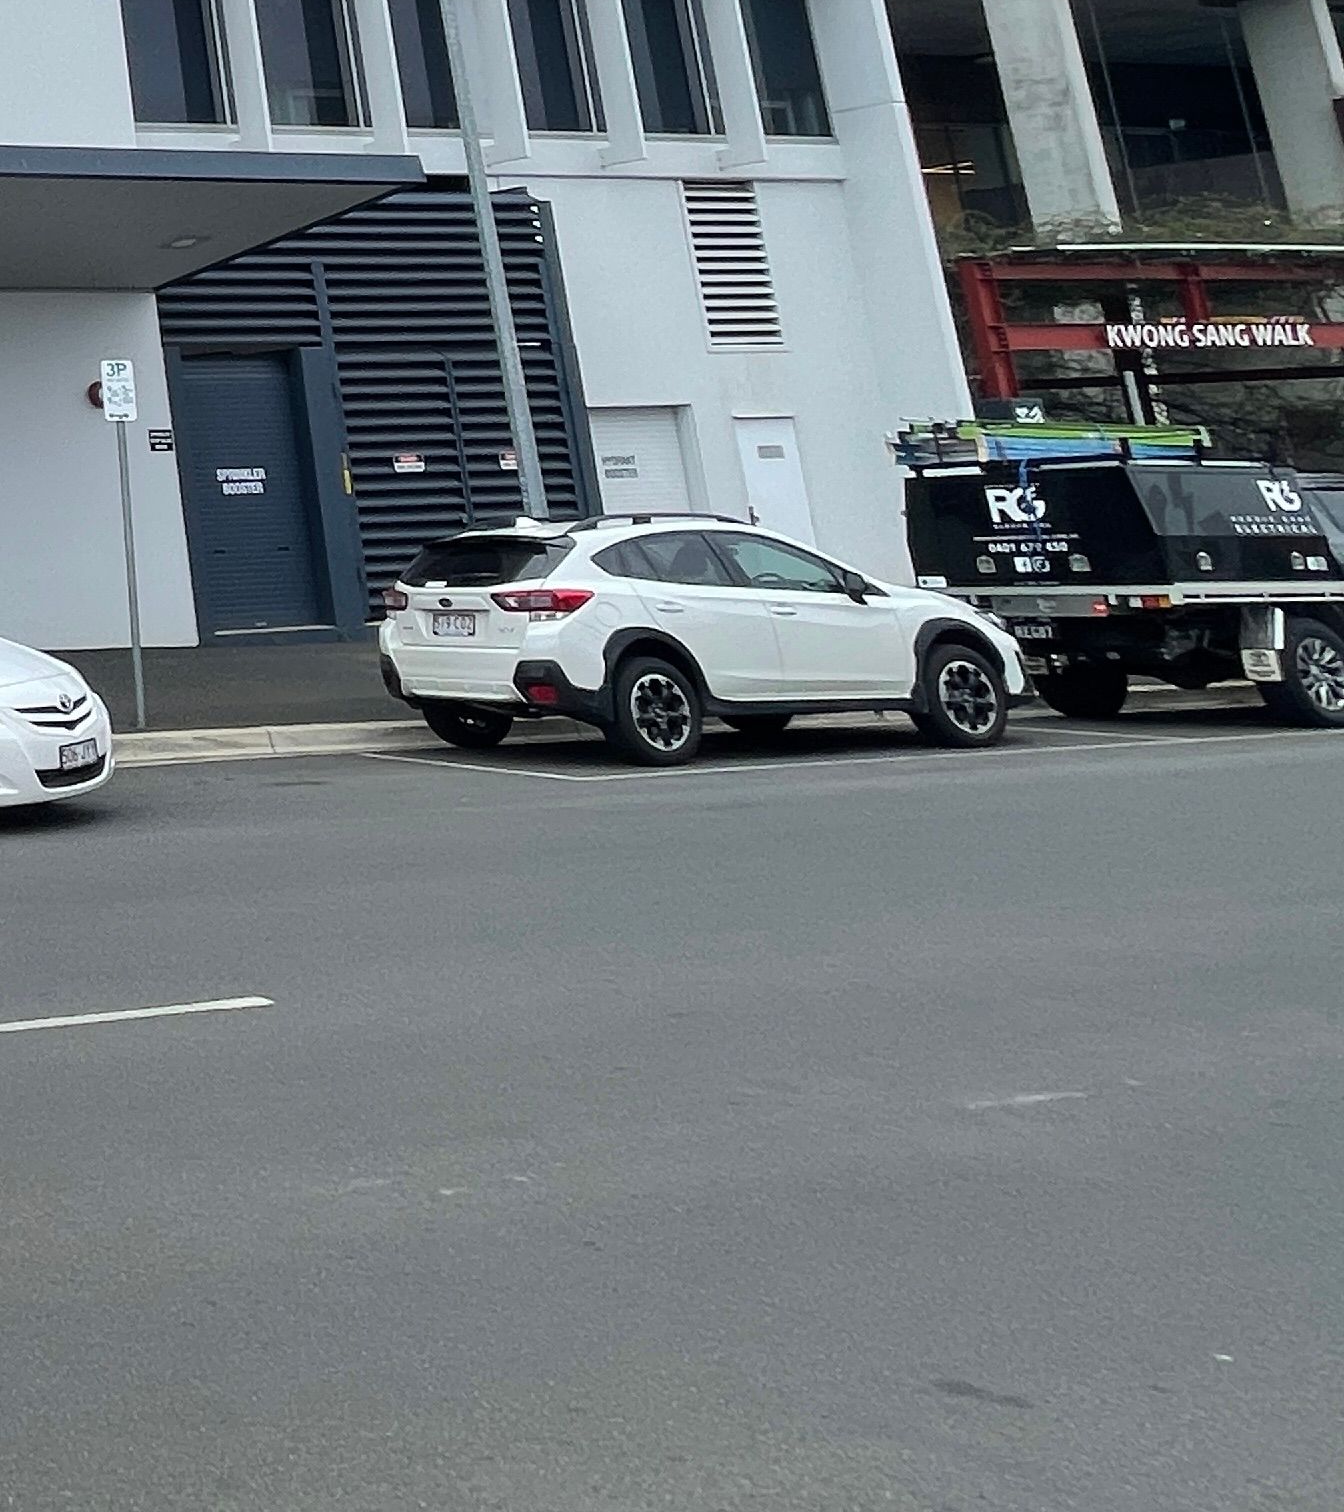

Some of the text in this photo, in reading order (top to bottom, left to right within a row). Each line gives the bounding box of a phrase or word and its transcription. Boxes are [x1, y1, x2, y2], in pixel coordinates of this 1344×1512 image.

[1106, 324, 1314, 348] KWONG SANG WALK
[106, 363, 127, 377] 3P
